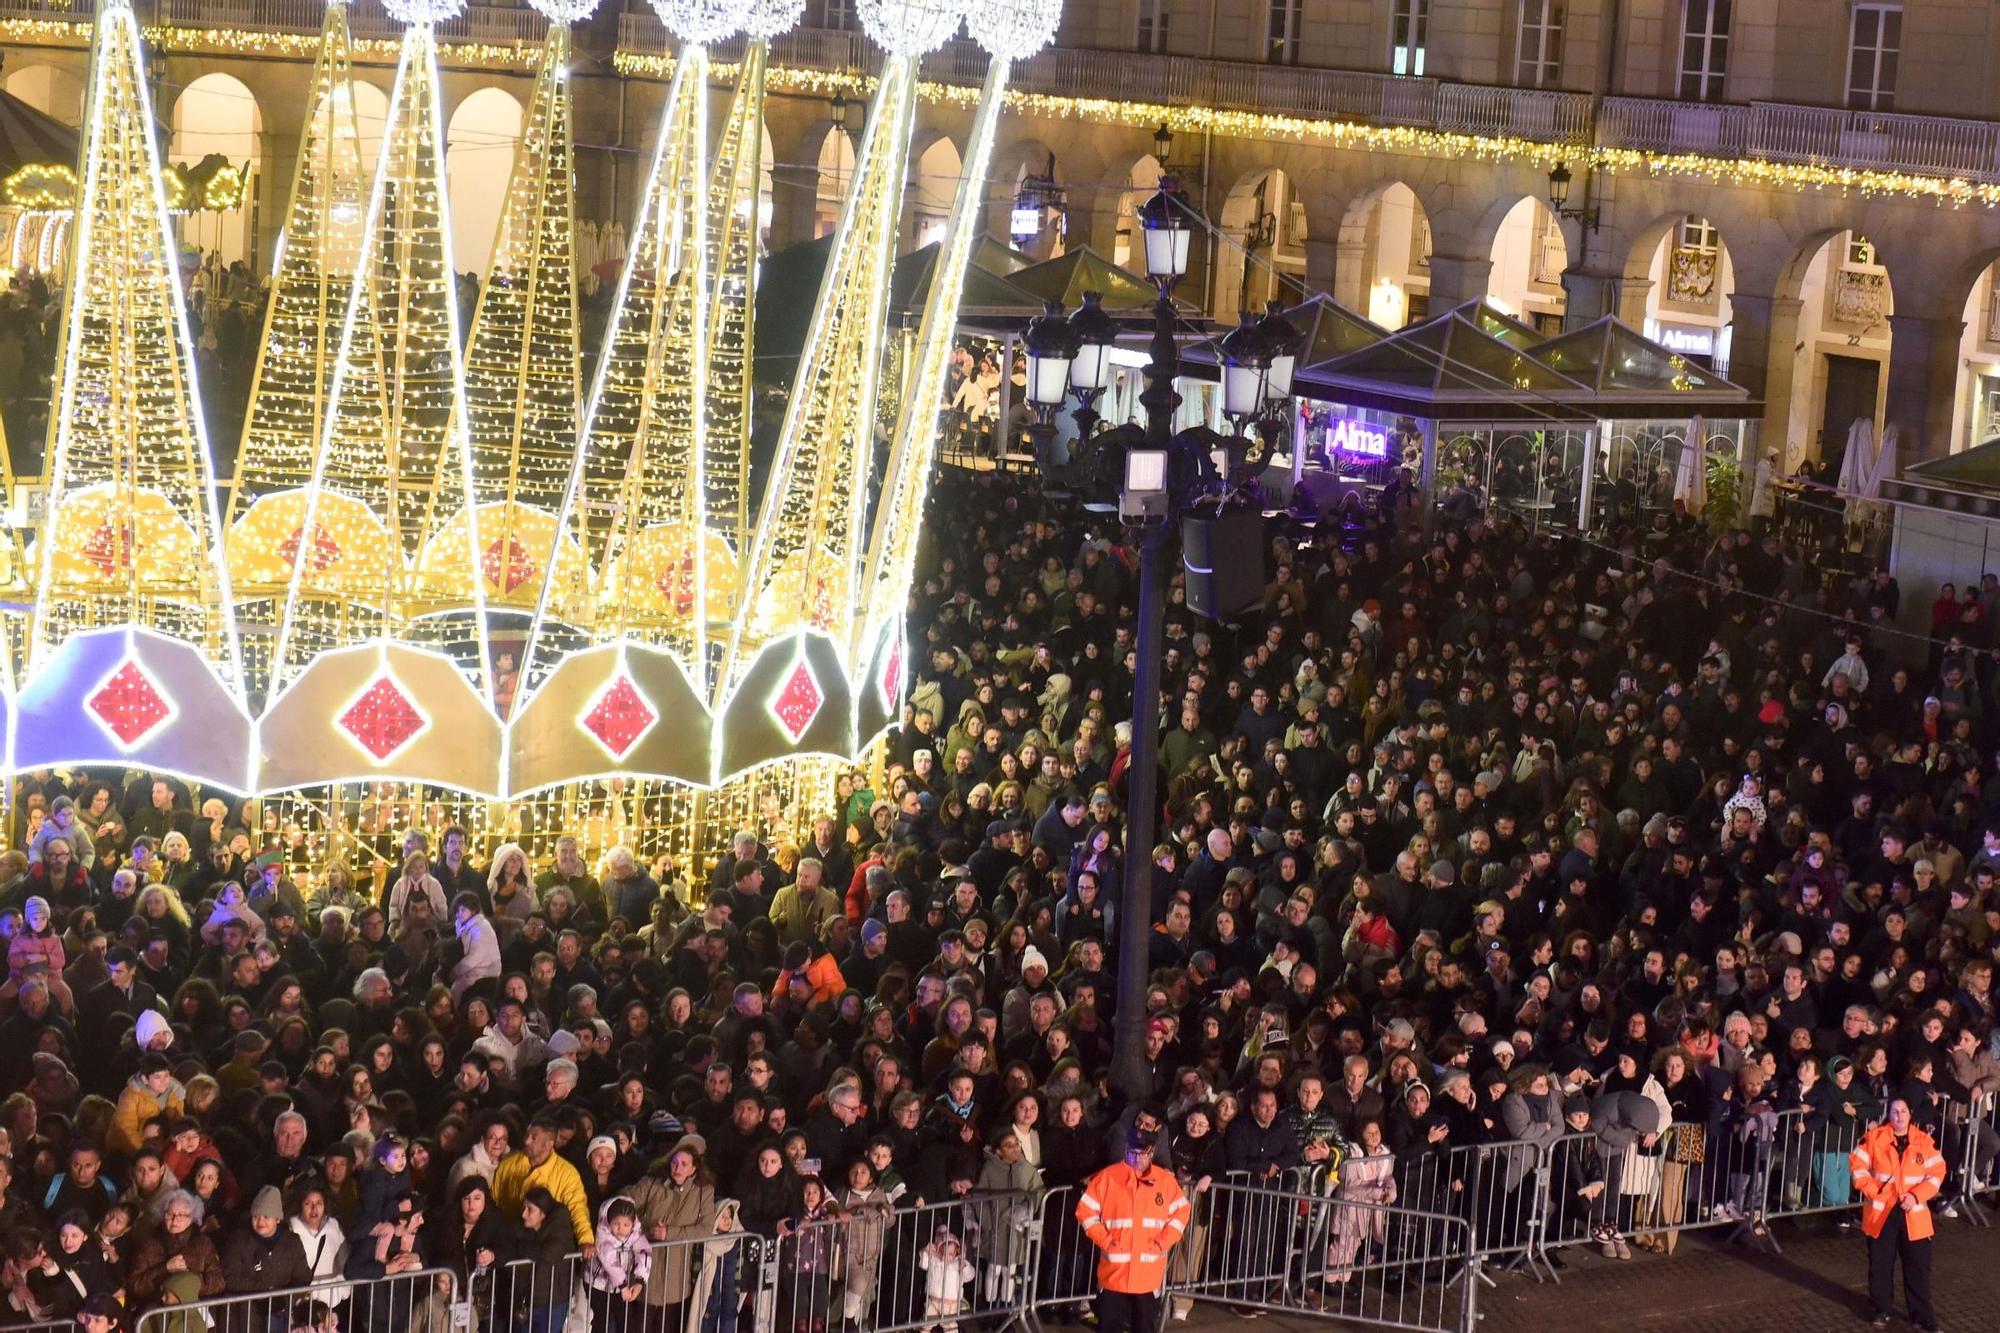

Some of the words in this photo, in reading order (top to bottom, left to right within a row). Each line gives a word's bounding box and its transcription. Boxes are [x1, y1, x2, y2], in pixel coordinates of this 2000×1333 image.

[1661, 329, 1710, 350] Alma
[1847, 334, 1861, 347] 22
[1332, 419, 1385, 456] Alma
